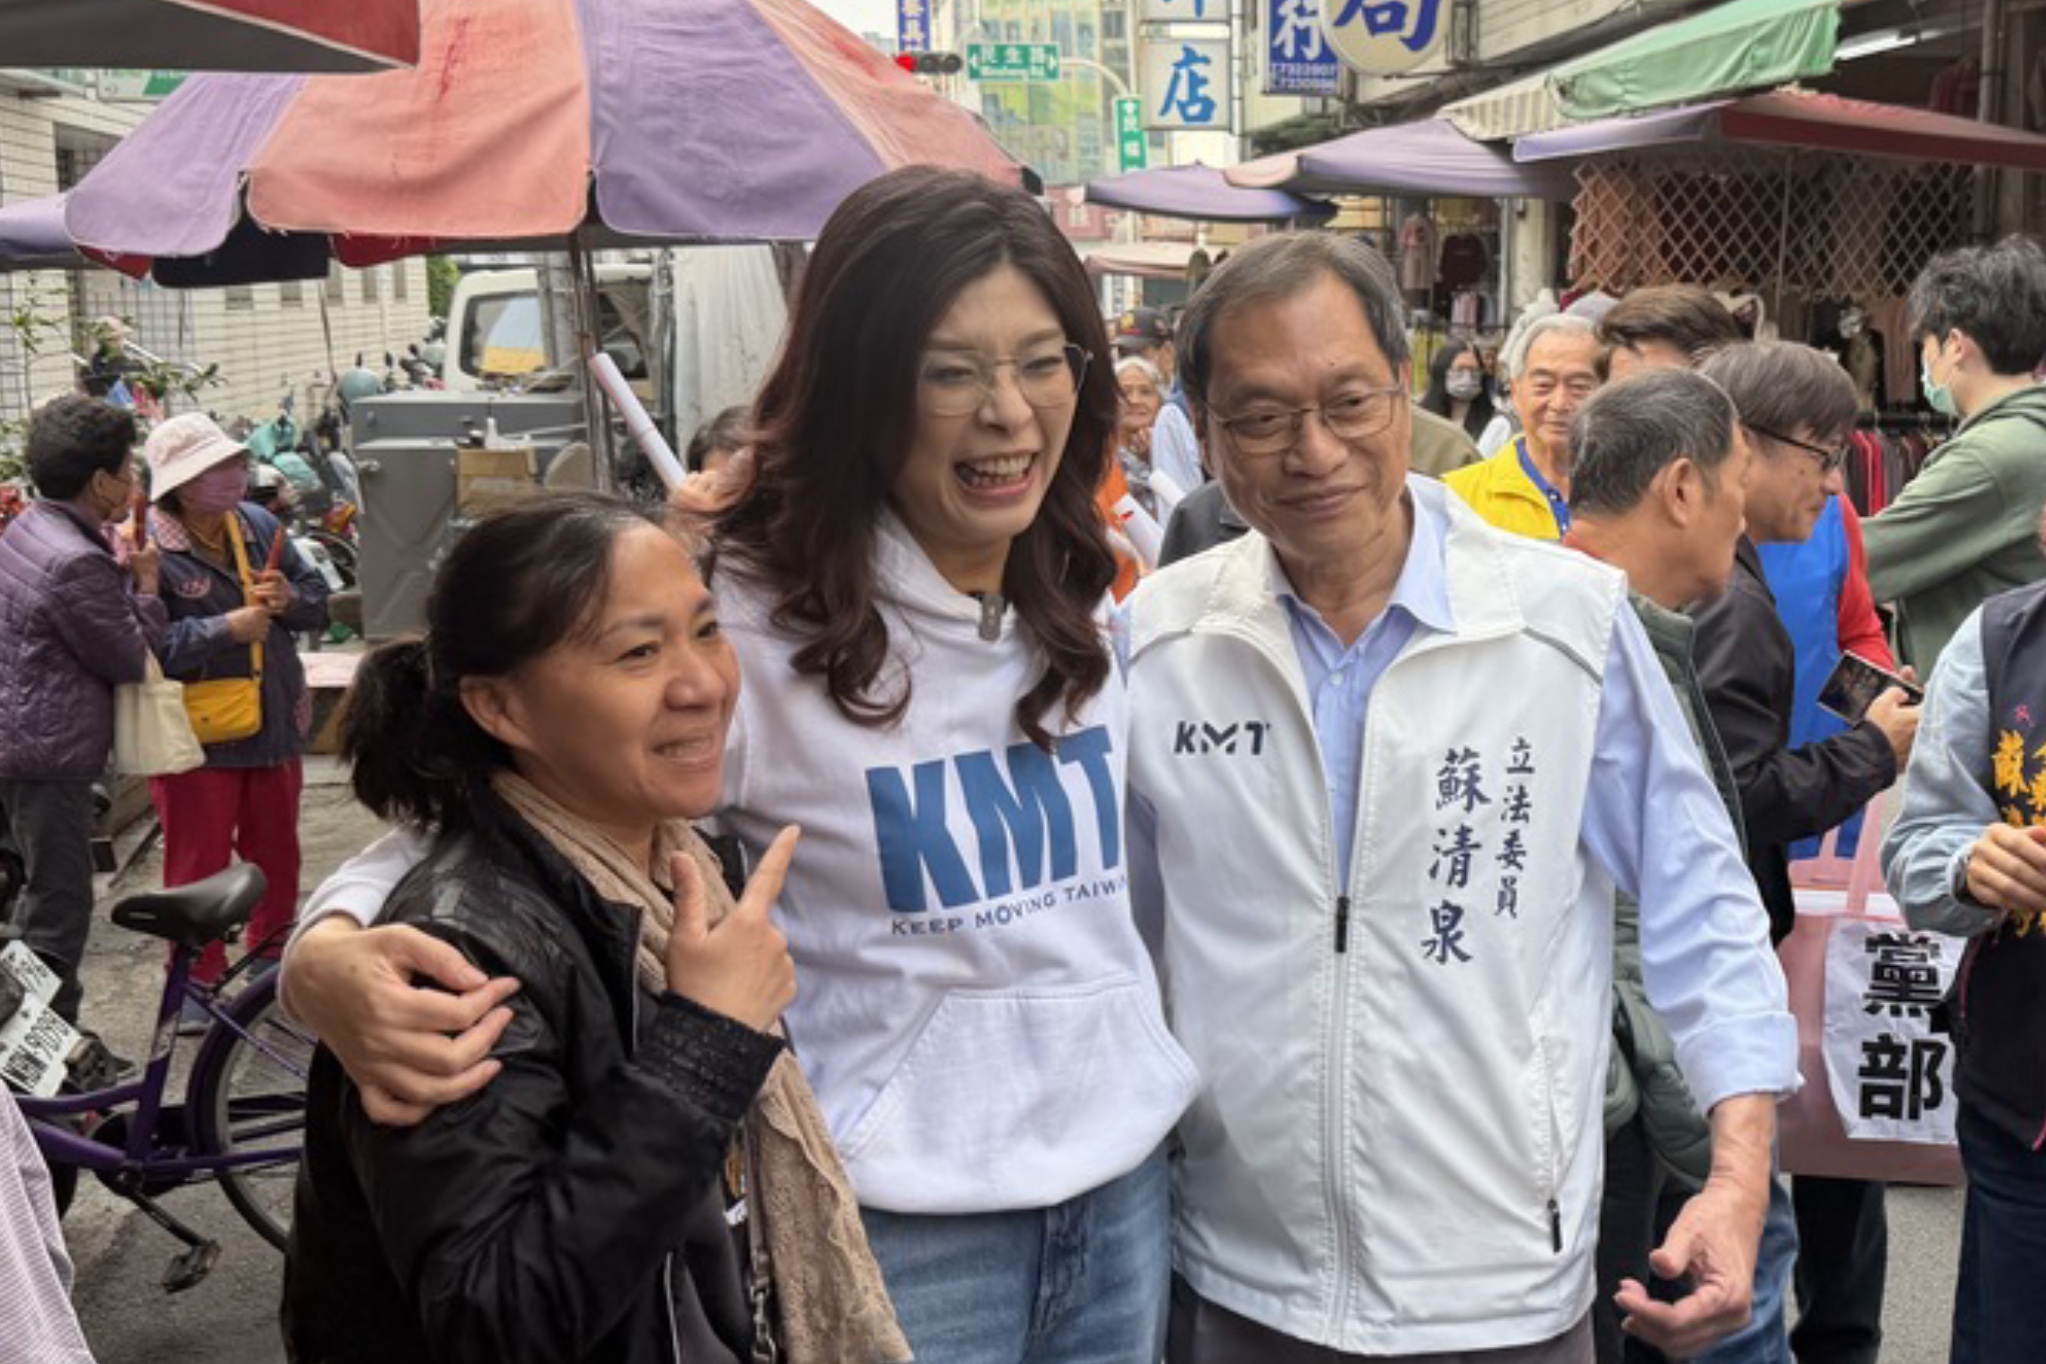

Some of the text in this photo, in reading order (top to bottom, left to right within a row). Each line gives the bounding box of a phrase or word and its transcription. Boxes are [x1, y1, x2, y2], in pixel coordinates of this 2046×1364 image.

[1158, 43, 1217, 123] 店
[865, 724, 1120, 913] KMT
[1173, 720, 1272, 755] KMT
[1494, 736, 1535, 919] 立法委員
[891, 917, 964, 936] KEEP
[975, 893, 1057, 930] MOVING
[1420, 745, 1492, 965] 蘇清泉
[1857, 933, 1947, 1120] 黨部
